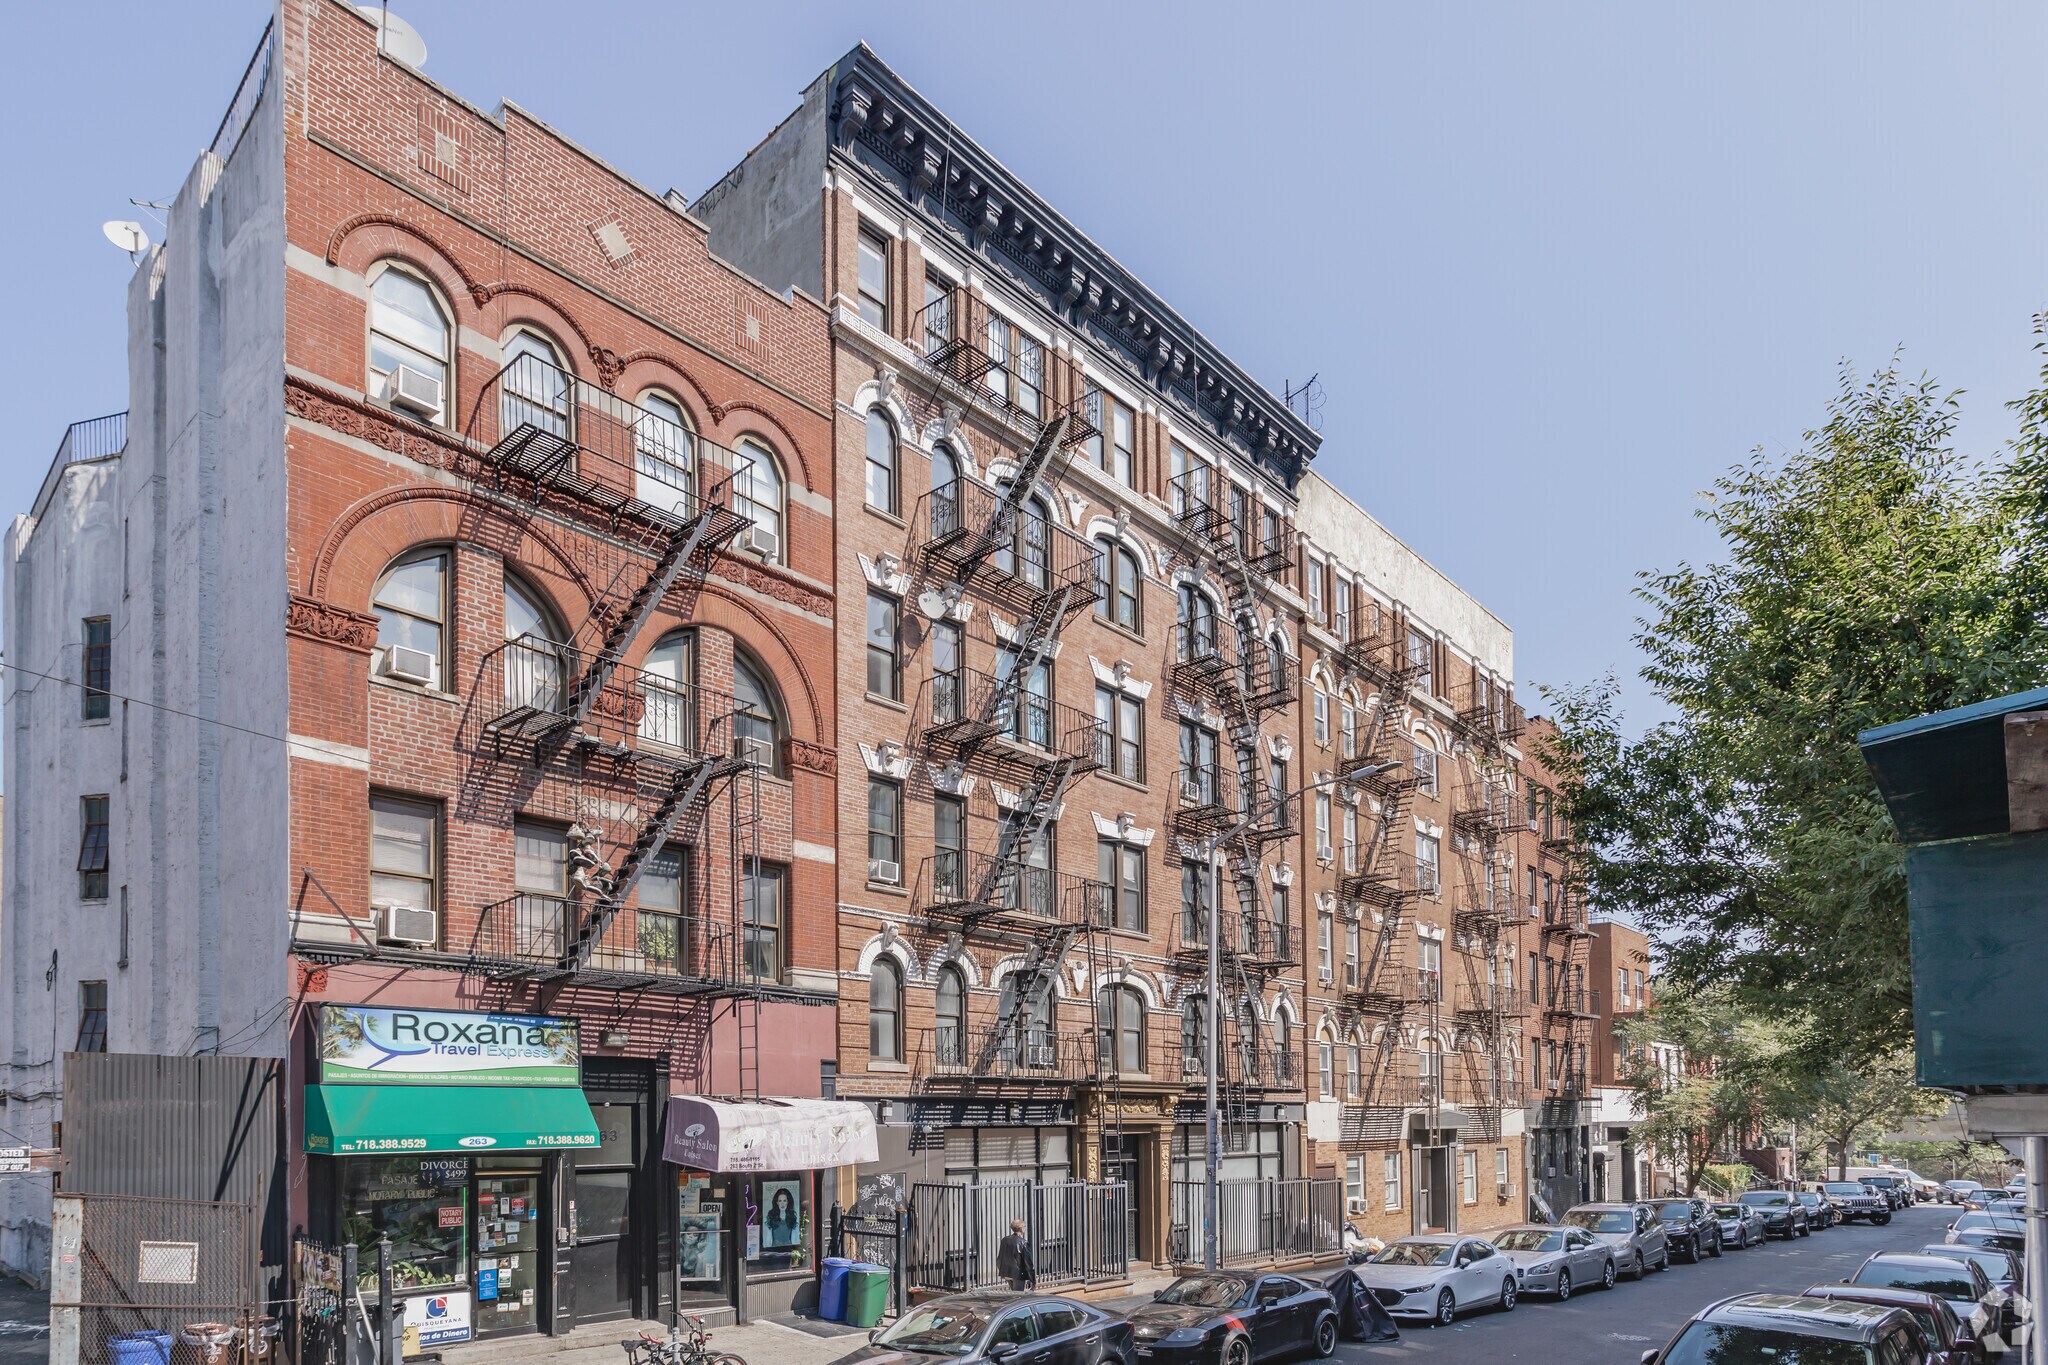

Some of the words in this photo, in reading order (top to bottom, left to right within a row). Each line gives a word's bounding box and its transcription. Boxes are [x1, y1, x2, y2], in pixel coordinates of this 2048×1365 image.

[392, 1013, 547, 1047] Roxana
[431, 1041, 481, 1056] Travel
[487, 1044, 550, 1060] Express
[538, 1135, 595, 1144] 718.388.9620
[600, 1130, 618, 1141] 63
[356, 1139, 427, 1150] 718.388.9529
[674, 1134, 696, 1150] Beauty
[697, 1138, 718, 1153] Salon
[0, 1149, 25, 1157] OSTED
[420, 1160, 469, 1170] DIVORCE
[444, 1169, 467, 1179] $499
[381, 1174, 419, 1185] PASAJE
[368, 1190, 402, 1201] NOTARY
[440, 1209, 463, 1217] NOTARY
[703, 1204, 721, 1213] OPEN
[441, 1217, 462, 1225] PUBLIC
[410, 1317, 462, 1327] QUISQUEYANA
[442, 1328, 468, 1338] Dinero
